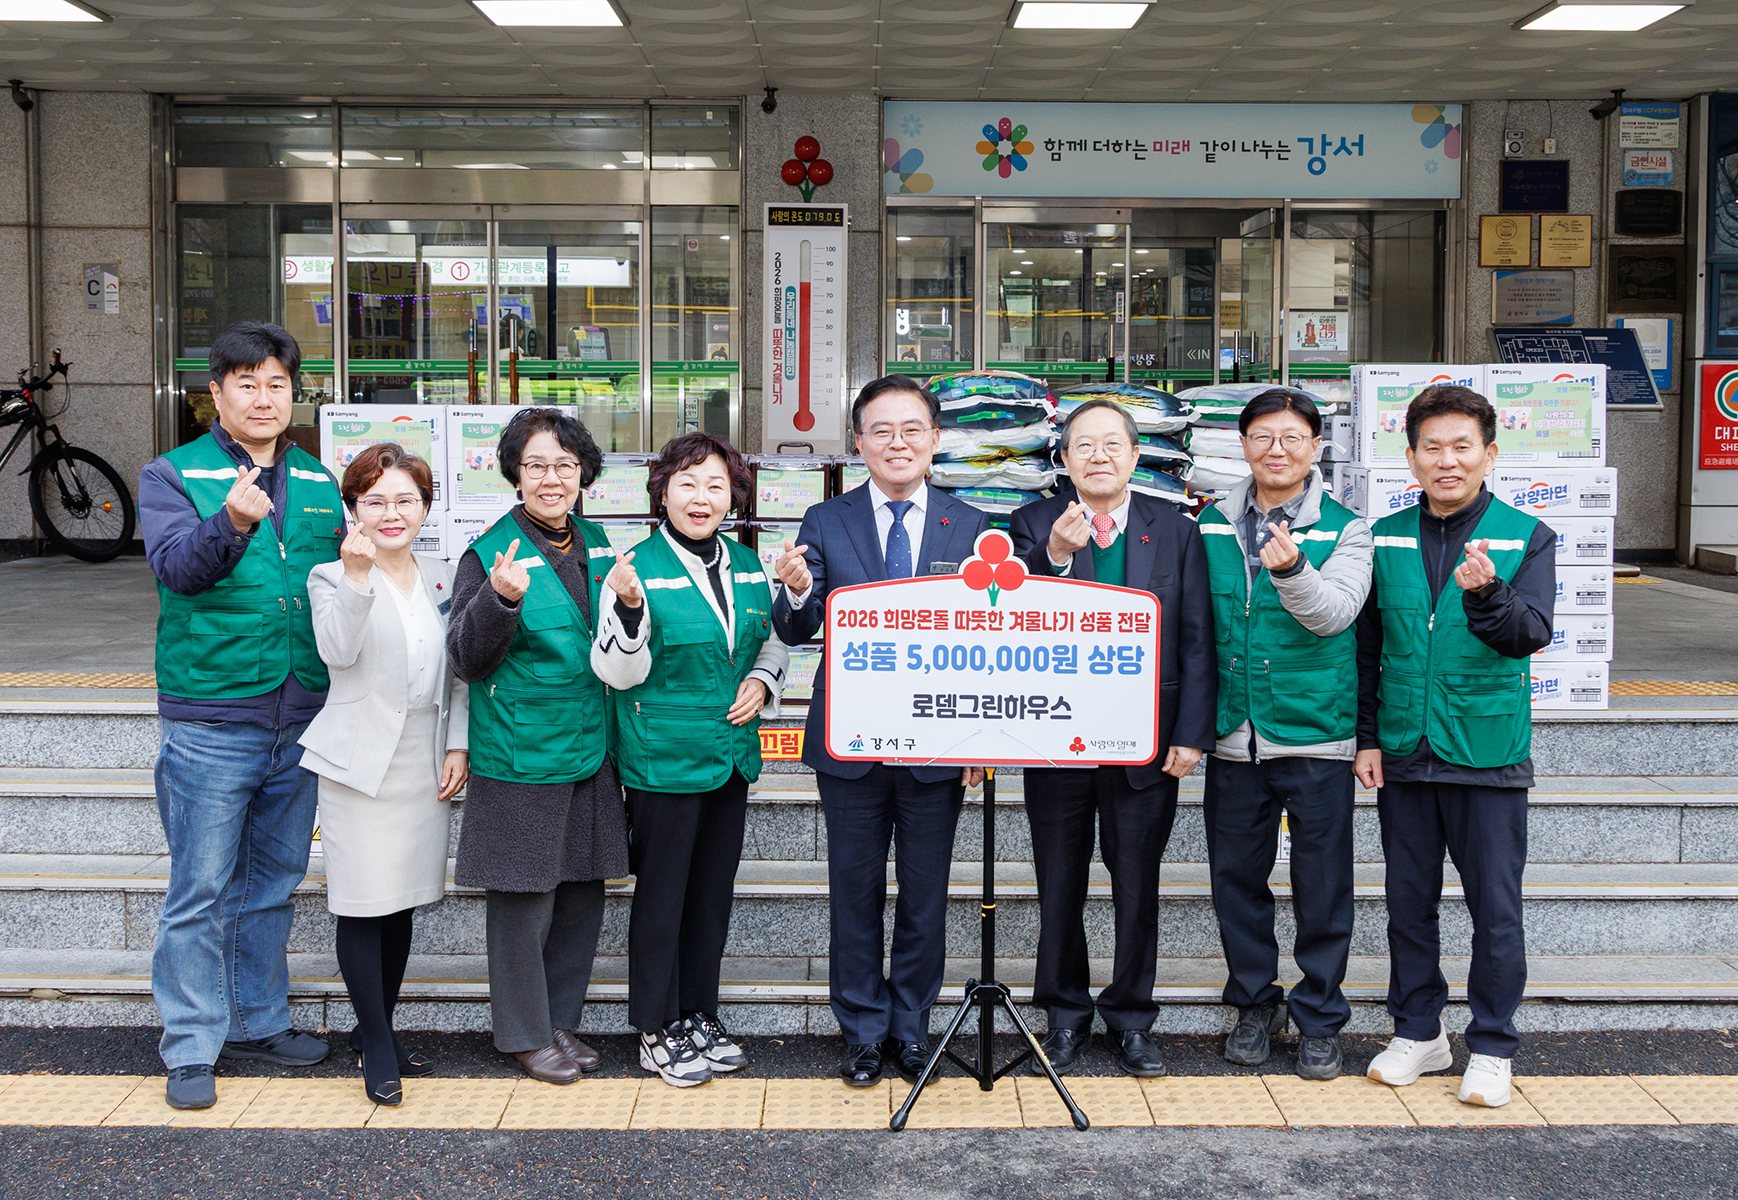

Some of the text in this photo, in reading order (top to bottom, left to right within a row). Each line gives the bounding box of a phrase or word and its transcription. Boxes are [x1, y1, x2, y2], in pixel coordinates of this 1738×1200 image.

[1043, 133, 1364, 176] 함께 더하는 미래 같이 나누는 강서
[1631, 154, 1667, 167] 금연시설
[771, 211, 840, 222] 사랑의 온도 079.0 도
[474, 261, 546, 274] 가관계등록
[774, 252, 782, 285] 2026
[88, 280, 100, 295] C
[774, 287, 782, 324] 희망온돌
[786, 292, 795, 376] 우리동네 나눔캠페인
[1198, 349, 1210, 359] IN
[772, 328, 783, 405] 따뜻한 겨울나기
[1560, 399, 1580, 407] 겨울나기
[1534, 419, 1586, 428] 가득한 김장김치
[1544, 411, 1566, 420] 사랑의
[1513, 485, 1568, 507] 삼양라면
[837, 608, 1151, 633] 2026 희망온돌 따뜻한 겨울나기 성품 전달
[841, 641, 1145, 676] 성품 5,000,000원 상당
[911, 693, 1073, 720] 로뎀그린하우스
[869, 737, 917, 751] 강서구
